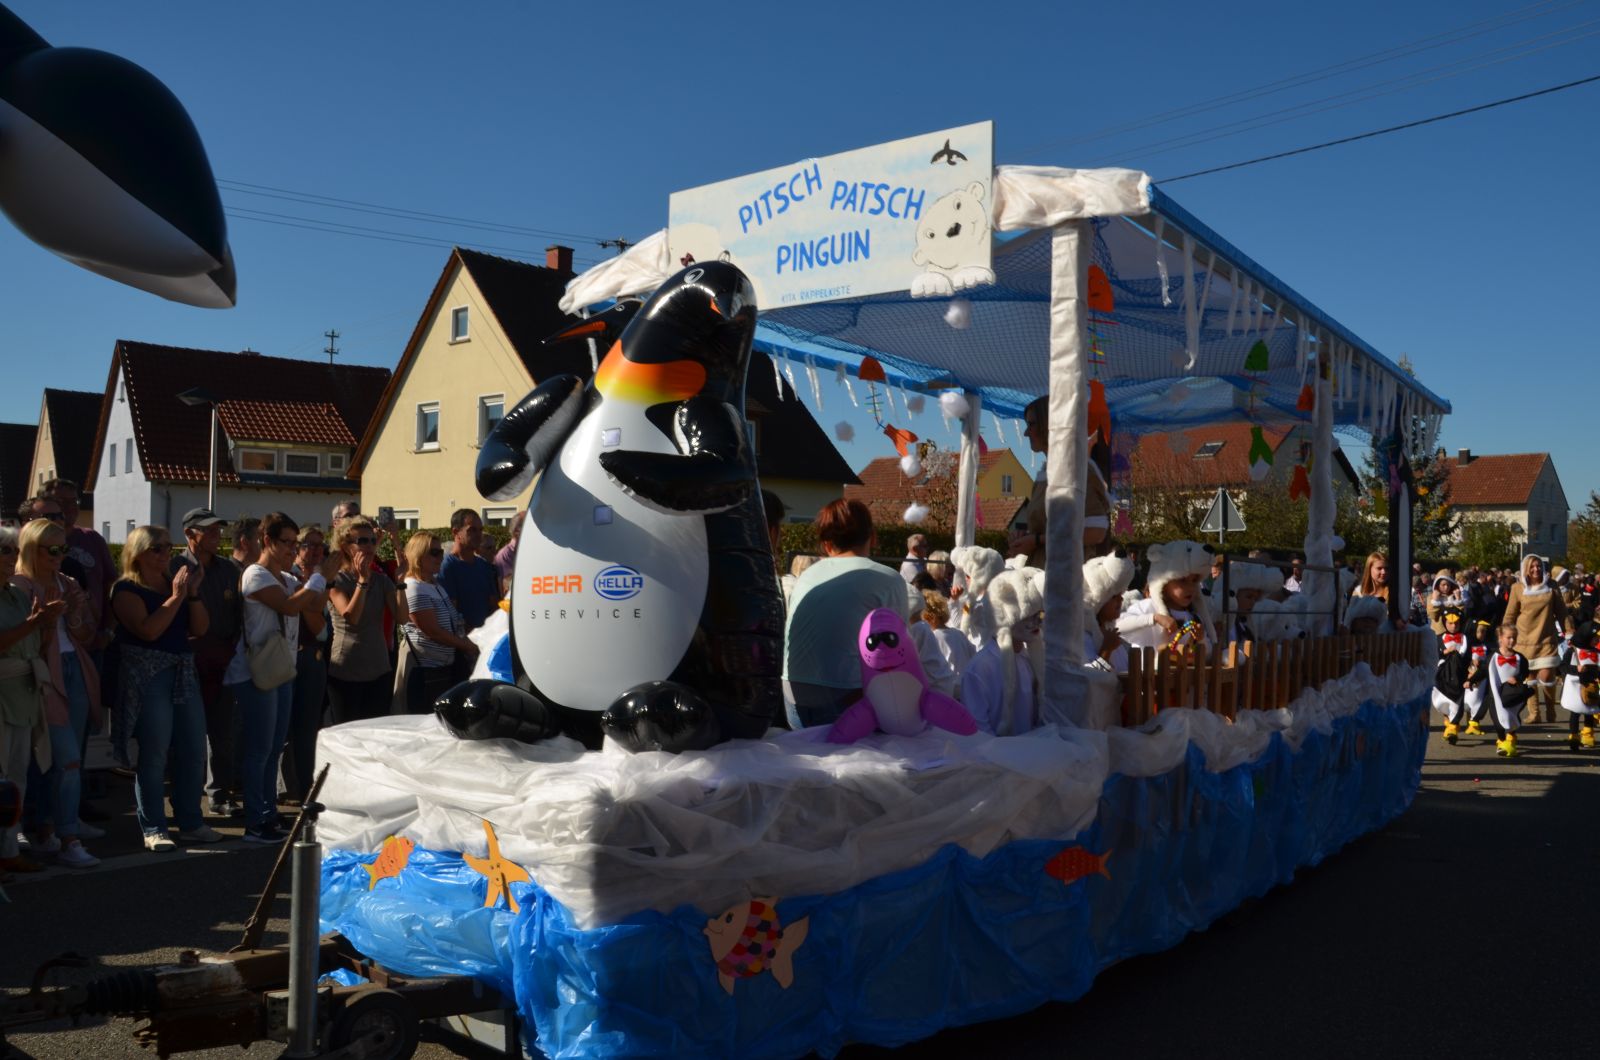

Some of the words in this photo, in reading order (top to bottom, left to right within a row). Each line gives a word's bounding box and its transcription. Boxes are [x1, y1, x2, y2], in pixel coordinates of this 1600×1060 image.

[738, 163, 823, 234] PITSCH
[830, 180, 926, 221] PATSCH
[776, 228, 871, 274] PINGUIN
[531, 574, 583, 594] BEHR
[599, 576, 643, 588] HELLA
[530, 608, 641, 619] SERVICE
